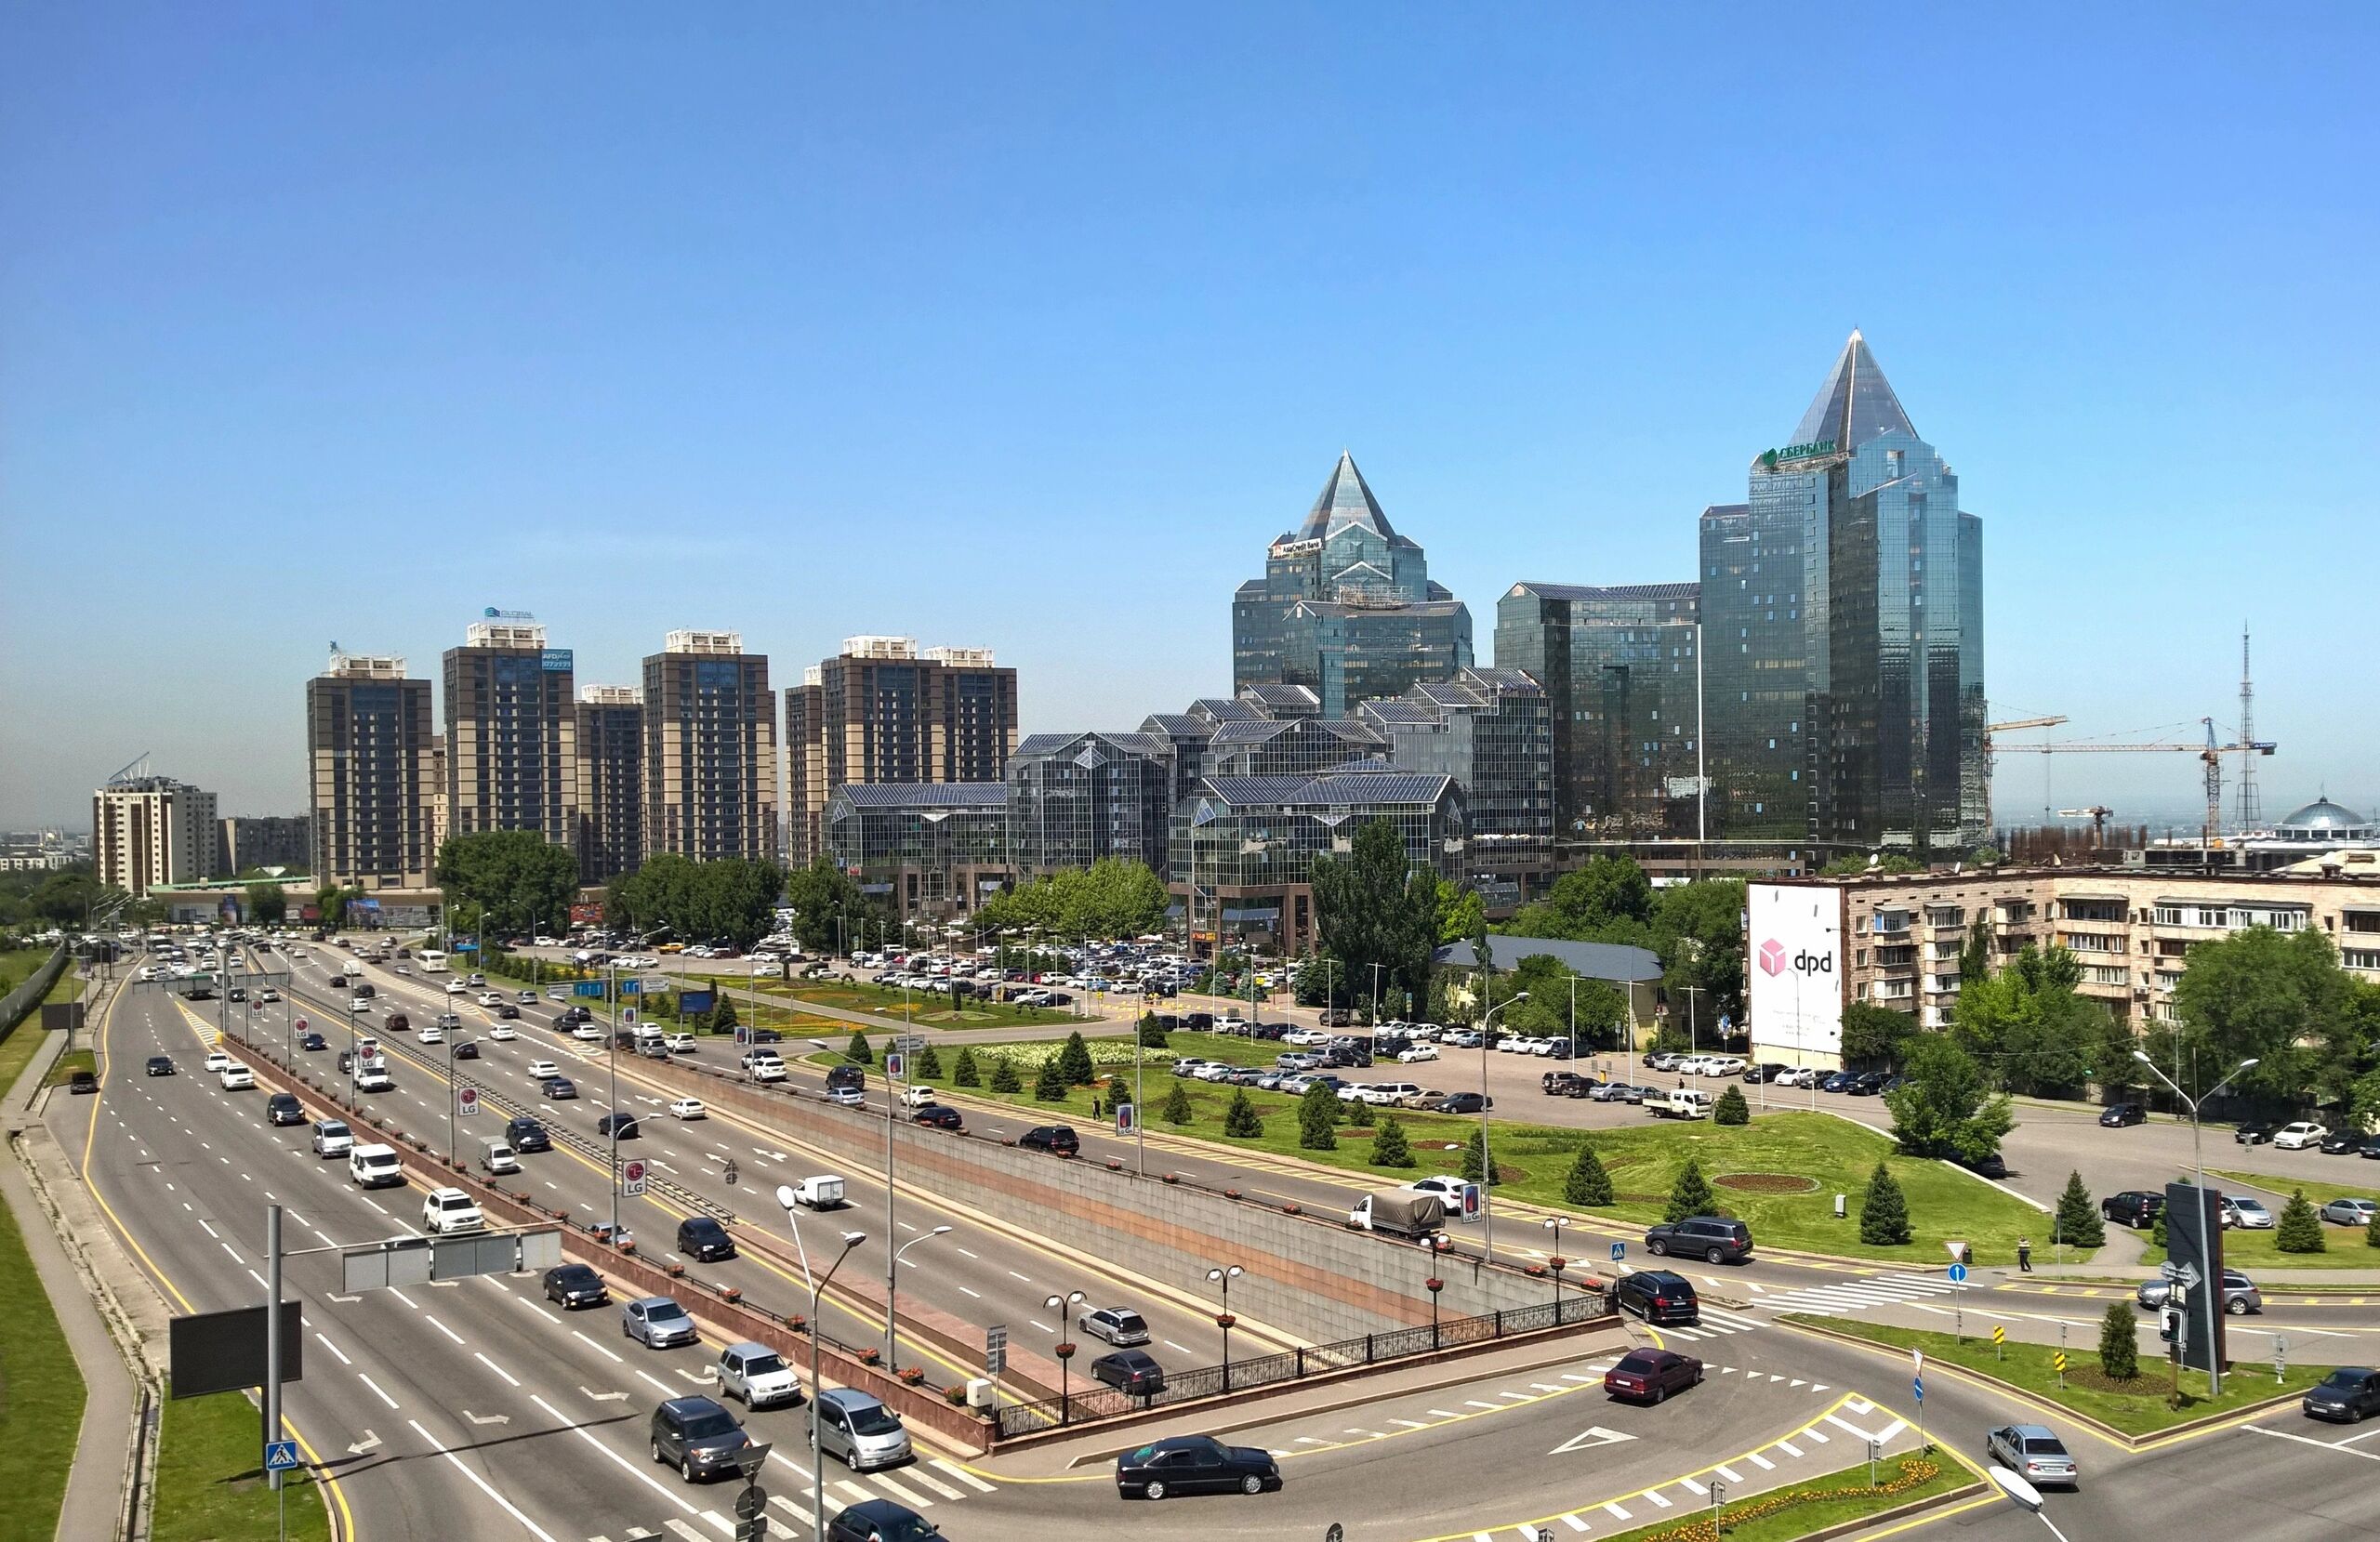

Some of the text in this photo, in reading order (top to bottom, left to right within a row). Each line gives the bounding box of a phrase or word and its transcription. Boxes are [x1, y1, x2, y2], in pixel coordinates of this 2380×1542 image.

[1779, 439, 1836, 459] СБЕРБАНК
[1307, 540, 1320, 549] Bank
[1794, 949, 1831, 976] dpd
[462, 1105, 475, 1114] LG
[628, 1183, 642, 1193] LG
